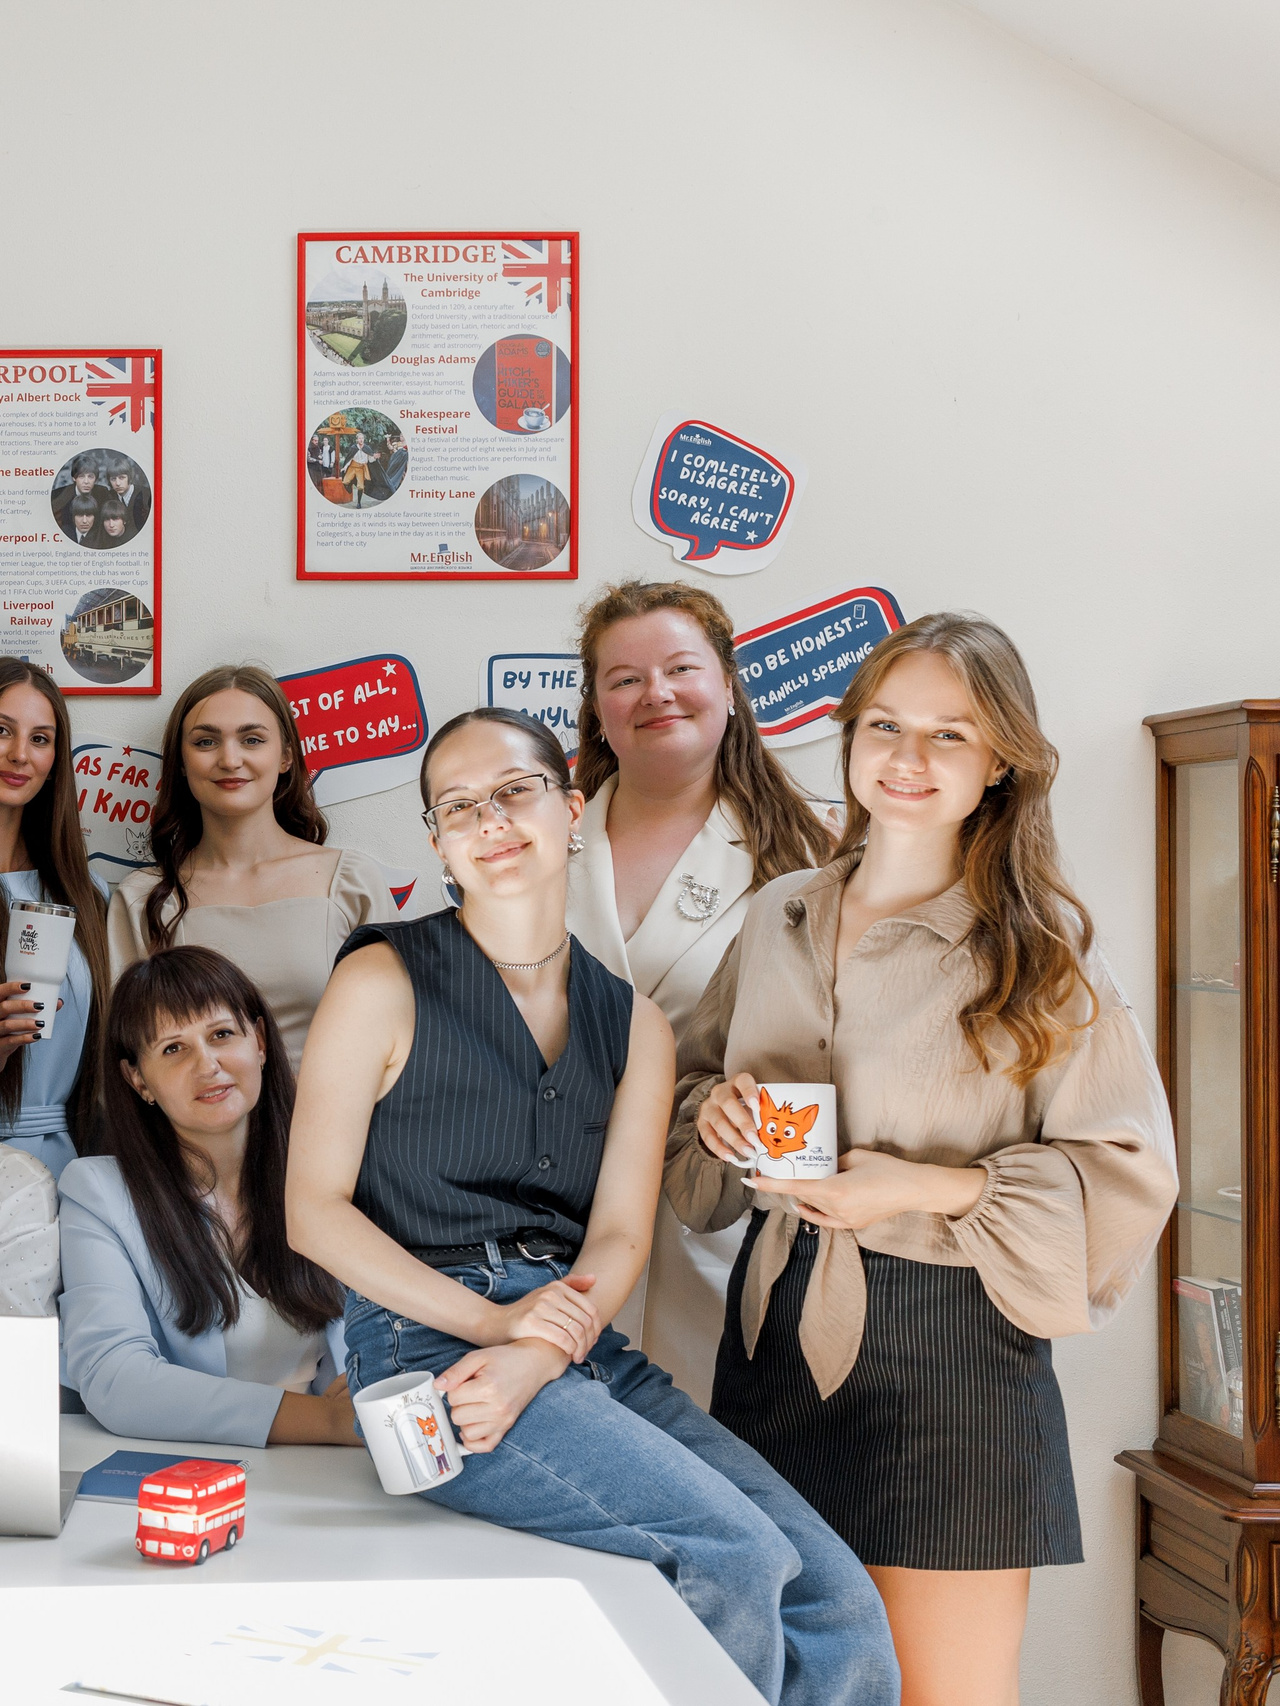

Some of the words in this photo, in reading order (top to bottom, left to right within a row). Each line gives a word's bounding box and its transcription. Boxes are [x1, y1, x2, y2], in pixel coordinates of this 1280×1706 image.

[335, 245, 496, 263] CAMBRIDGE
[404, 273, 424, 282] The
[427, 273, 484, 284] University
[486, 273, 498, 282] of
[421, 288, 481, 300] Cambridge
[391, 355, 435, 366] Douglas
[438, 355, 476, 364] Adams
[16, 393, 50, 402] Albert
[53, 393, 81, 402] Dock
[498, 388, 534, 399] GUIDE
[498, 399, 546, 409] GALAXY
[2, 411, 29, 419] complex
[55, 411, 85, 419] buildings
[399, 410, 471, 421] Shakespeare
[415, 425, 458, 434] Festival
[472, 436, 489, 444] plays
[523, 436, 565, 444] Shakespeare
[680, 434, 712, 446] Mr.English
[14, 468, 55, 477] Beatles
[671, 450, 677, 462] I
[683, 454, 781, 487] COMLETELY
[680, 468, 762, 500] DISAGREE.
[409, 490, 446, 501] Trinity
[449, 490, 476, 499] Lane
[659, 487, 712, 512] SORRY,
[718, 502, 724, 514] I
[730, 506, 774, 525] CAN'T
[316, 521, 352, 529] Cambridge
[441, 521, 473, 529] University
[690, 512, 739, 532] AGREE
[41, 533, 50, 543] F.
[53, 533, 63, 543] C.
[410, 552, 472, 565] Mr.English
[3, 601, 54, 612] Liverpool
[10, 616, 53, 628] Railway
[739, 663, 762, 683] TO
[765, 649, 789, 670] BE
[790, 617, 868, 660] HONEST...
[503, 671, 531, 689] BY
[538, 670, 577, 689] THE
[289, 698, 310, 719] ST
[318, 690, 344, 710] OF
[354, 679, 397, 704] ALL,
[750, 673, 808, 713] FRANKLY
[300, 734, 329, 756] IKE
[333, 726, 359, 746] TO
[366, 715, 416, 739] SAY...
[75, 755, 101, 776] AS
[107, 763, 149, 788] FAR
